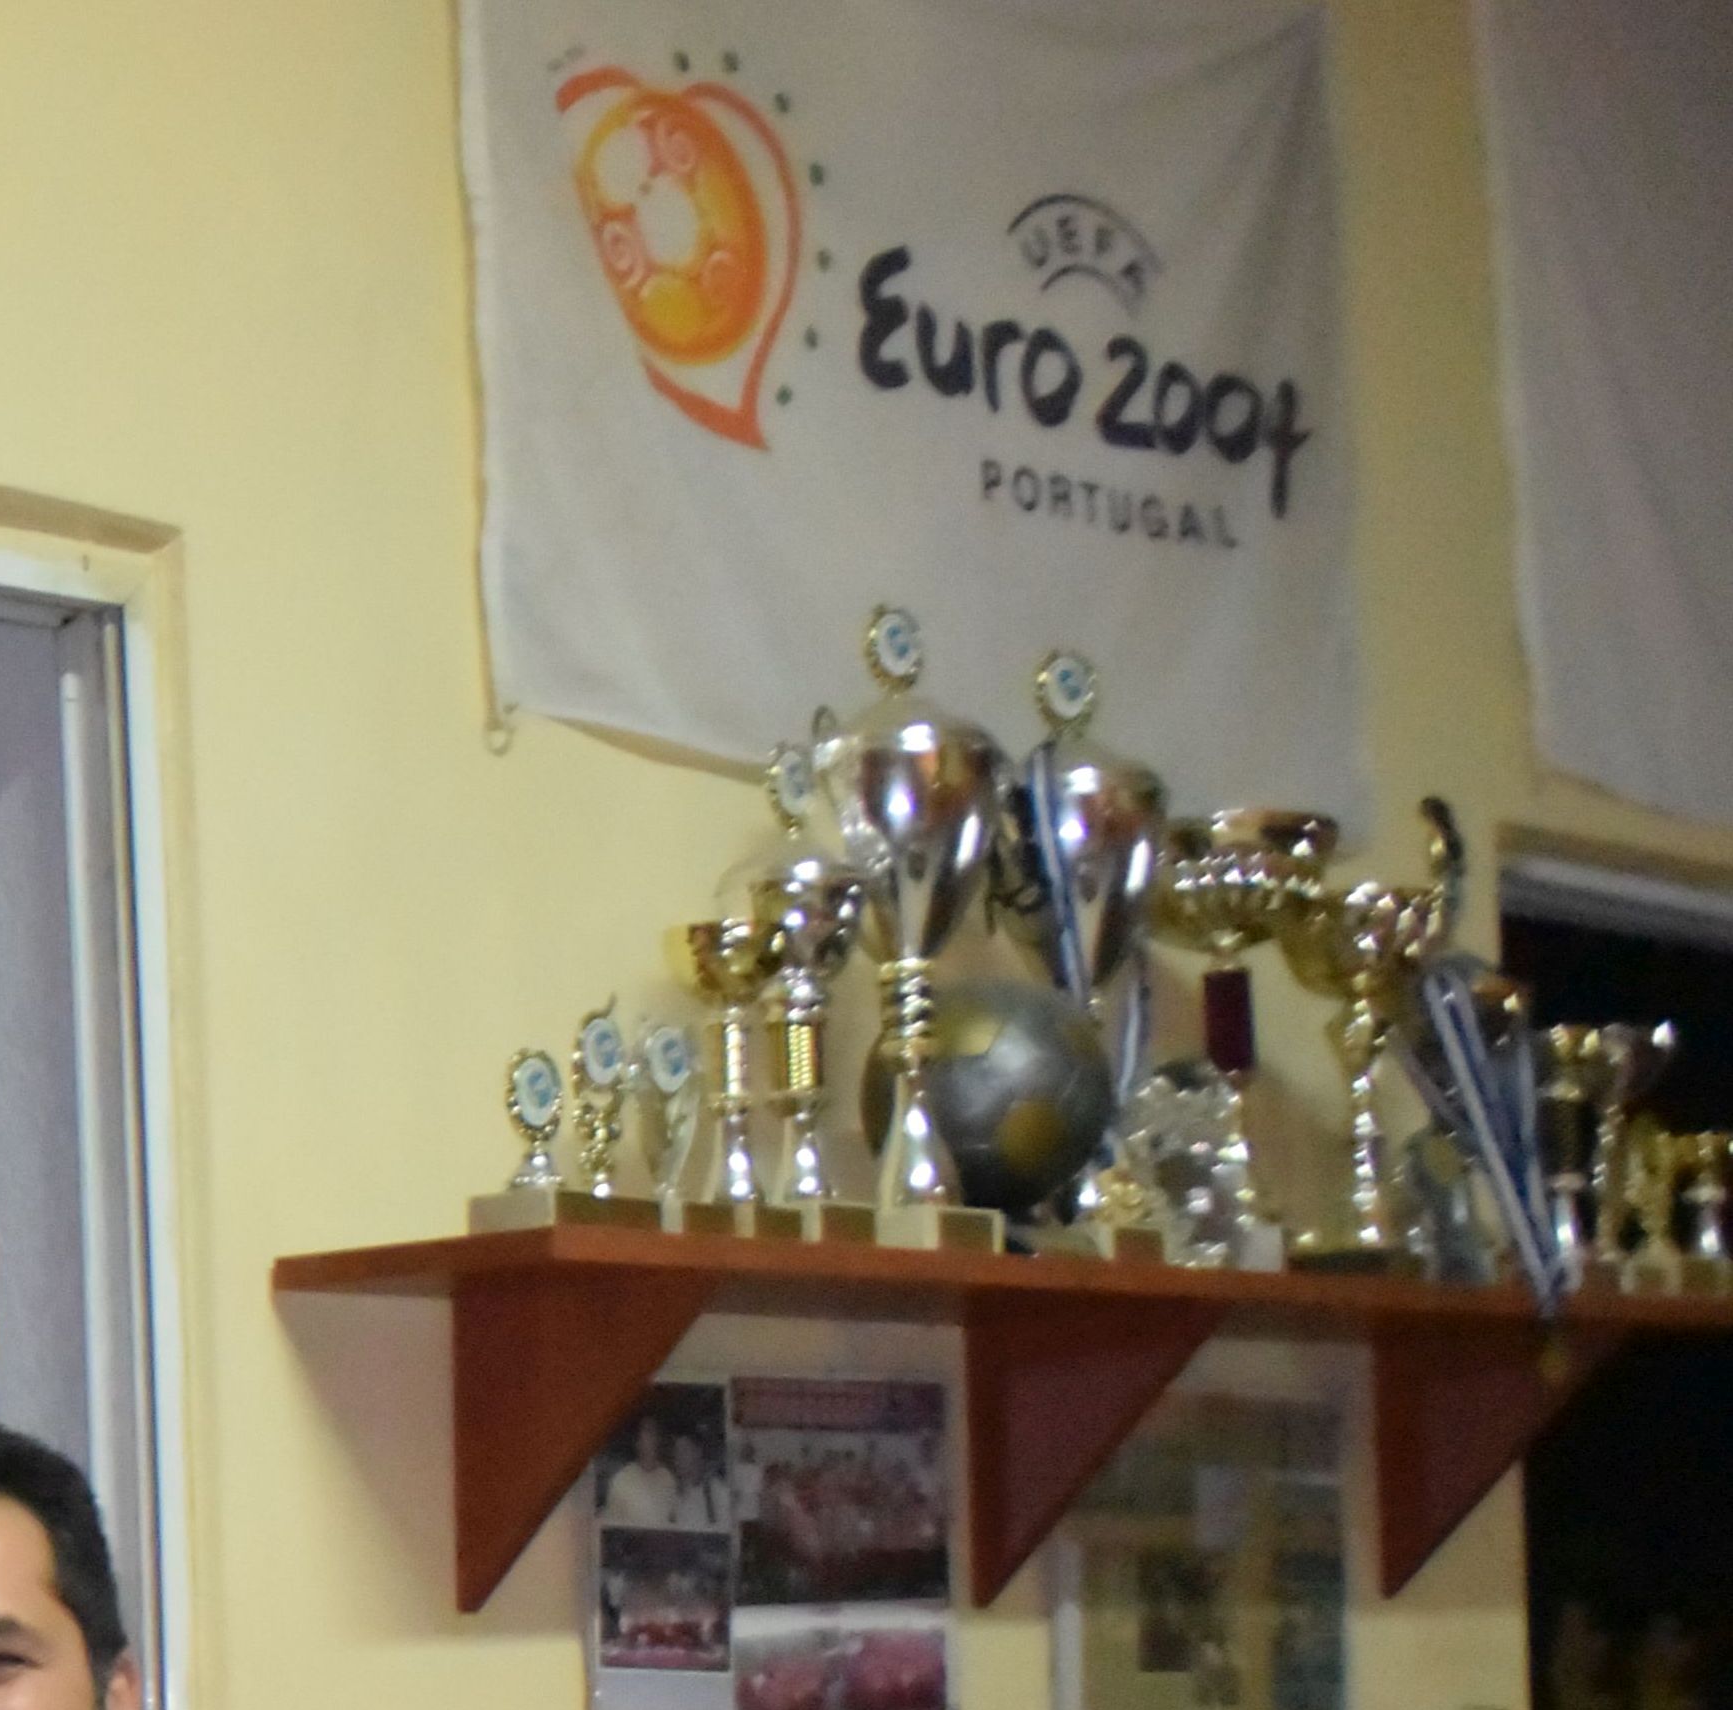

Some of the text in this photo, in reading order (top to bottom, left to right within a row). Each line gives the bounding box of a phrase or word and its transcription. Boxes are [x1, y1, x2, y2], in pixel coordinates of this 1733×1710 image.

[1020, 213, 1149, 303] UEFA
[1096, 334, 1313, 520] 2004
[981, 459, 1239, 549] PORTUGAL
